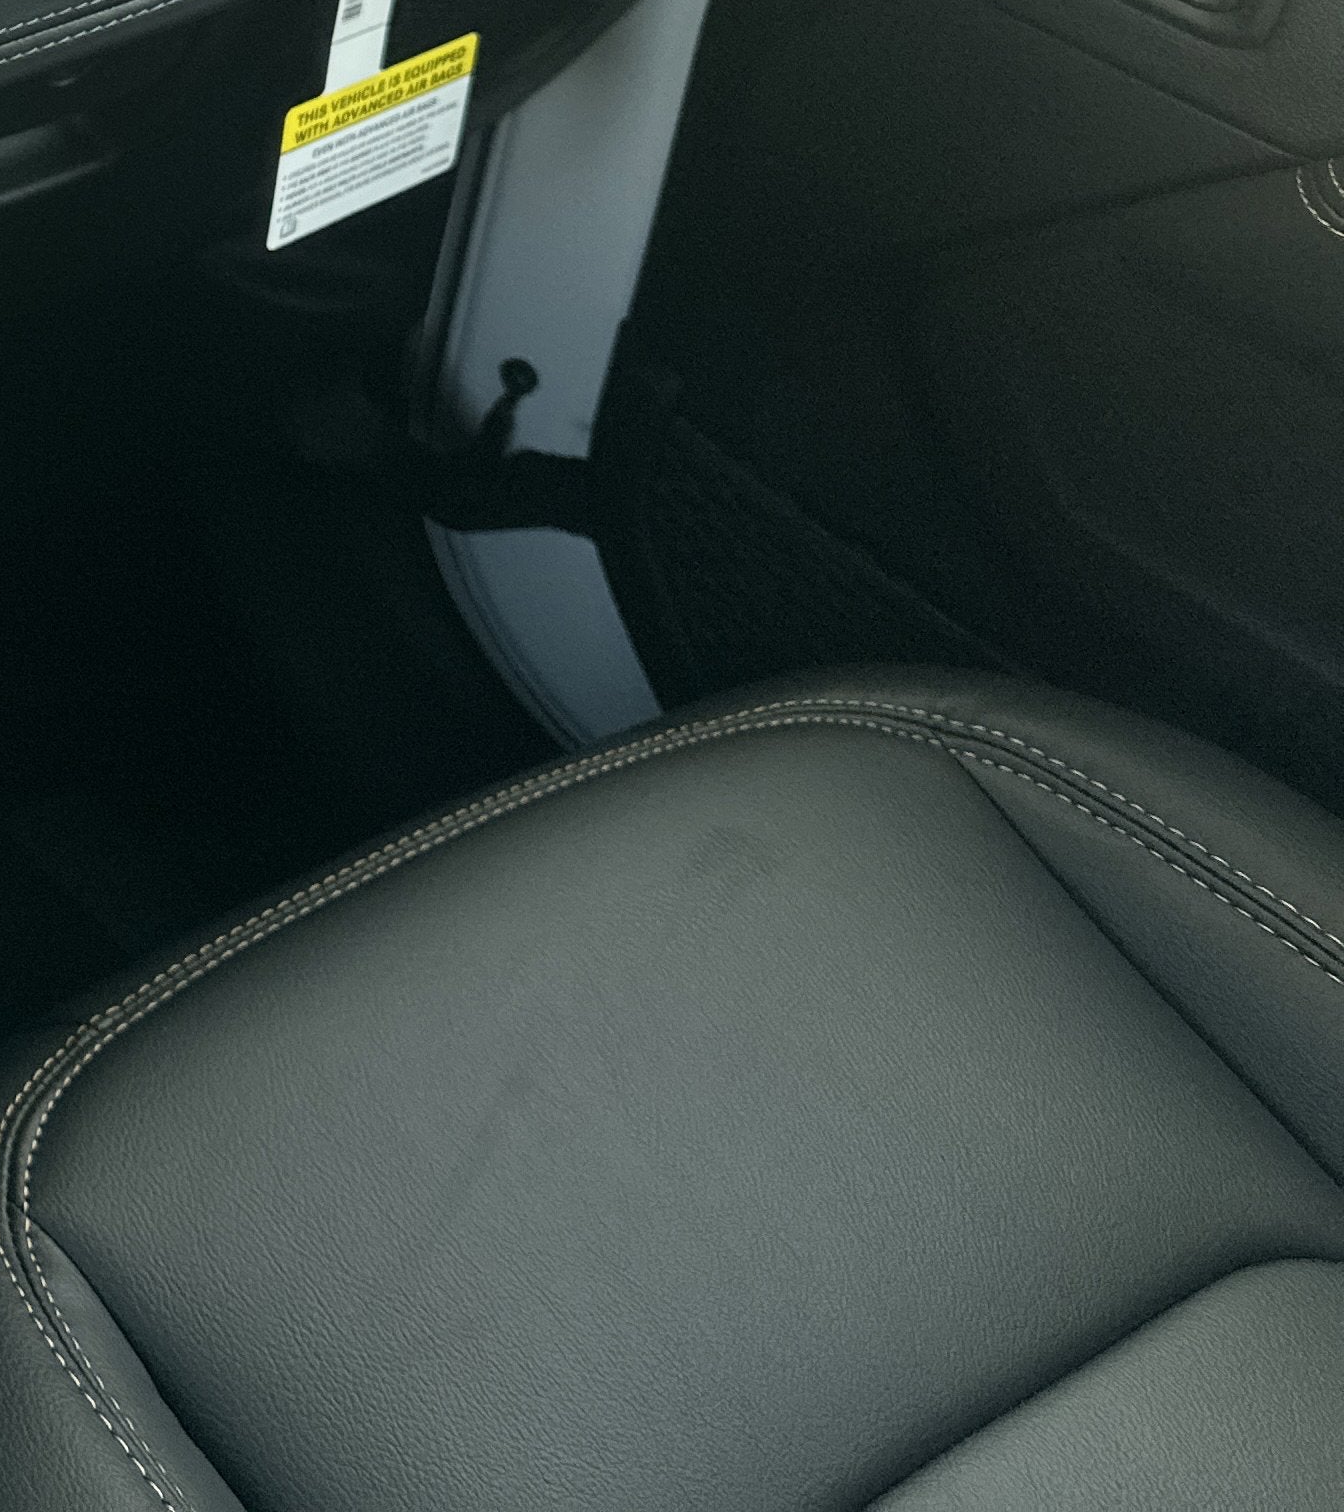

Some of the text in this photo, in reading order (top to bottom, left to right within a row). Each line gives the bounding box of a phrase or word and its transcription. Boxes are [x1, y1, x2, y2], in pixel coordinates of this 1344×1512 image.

[294, 63, 464, 144] WITH ADVANCED AIR BAGS
[297, 45, 467, 126] THIS VEHICLE IS EQUIPPED
